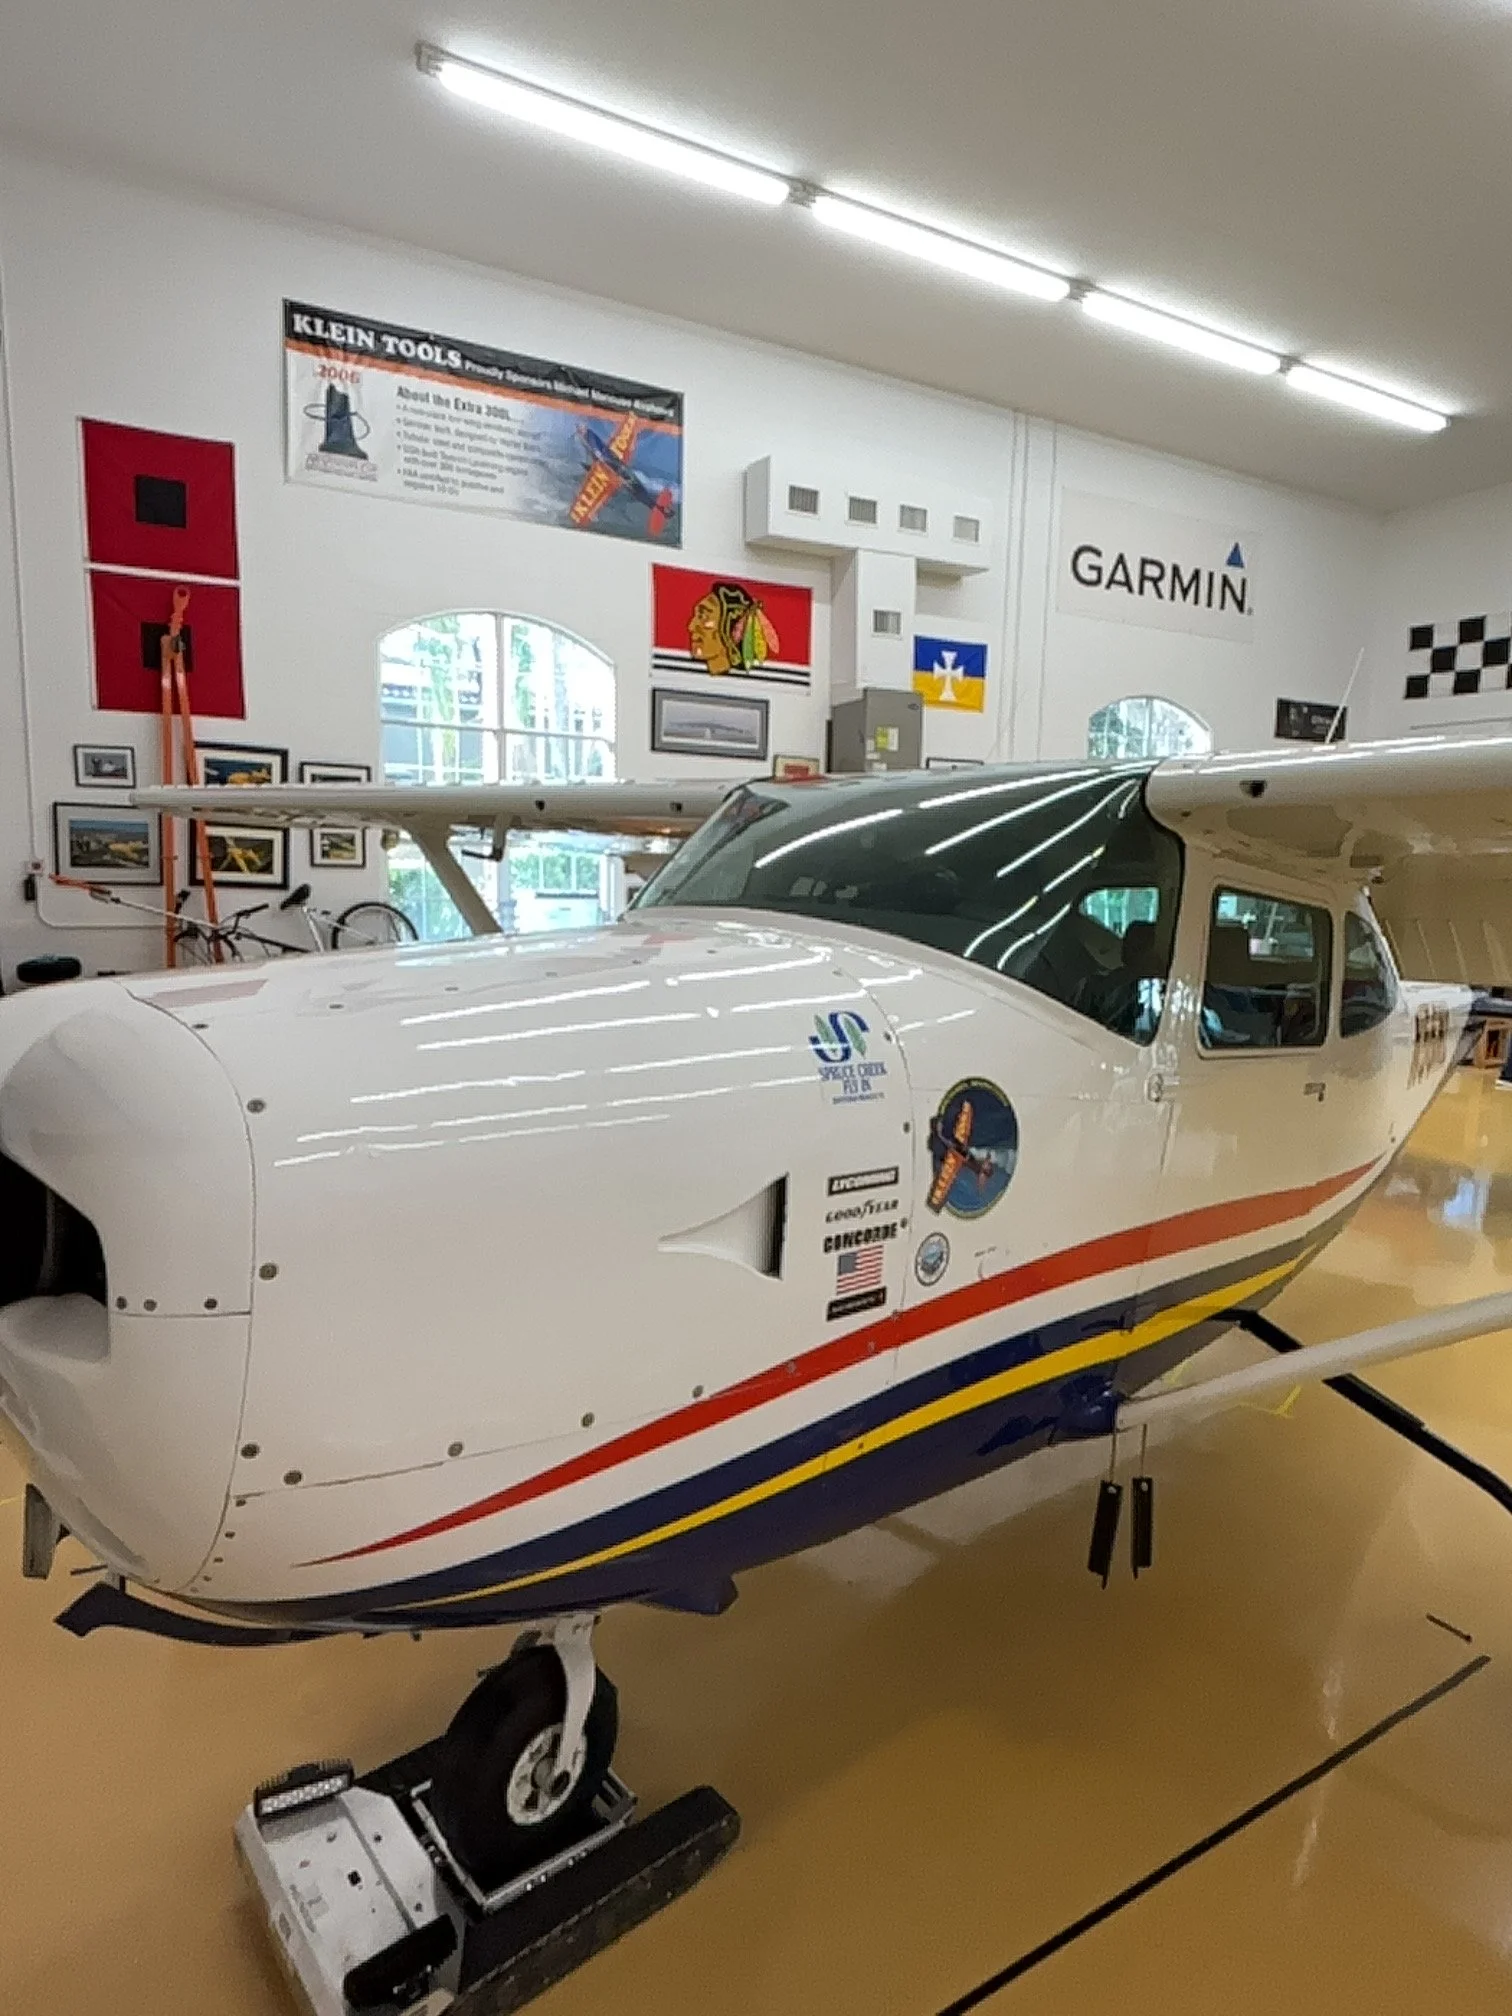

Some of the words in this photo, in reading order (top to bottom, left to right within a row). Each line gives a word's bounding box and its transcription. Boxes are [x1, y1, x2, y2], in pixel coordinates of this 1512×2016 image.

[293, 313, 375, 350] KLEIN
[382, 337, 462, 369] TOOLS
[1071, 544, 1247, 614] GARMIN
